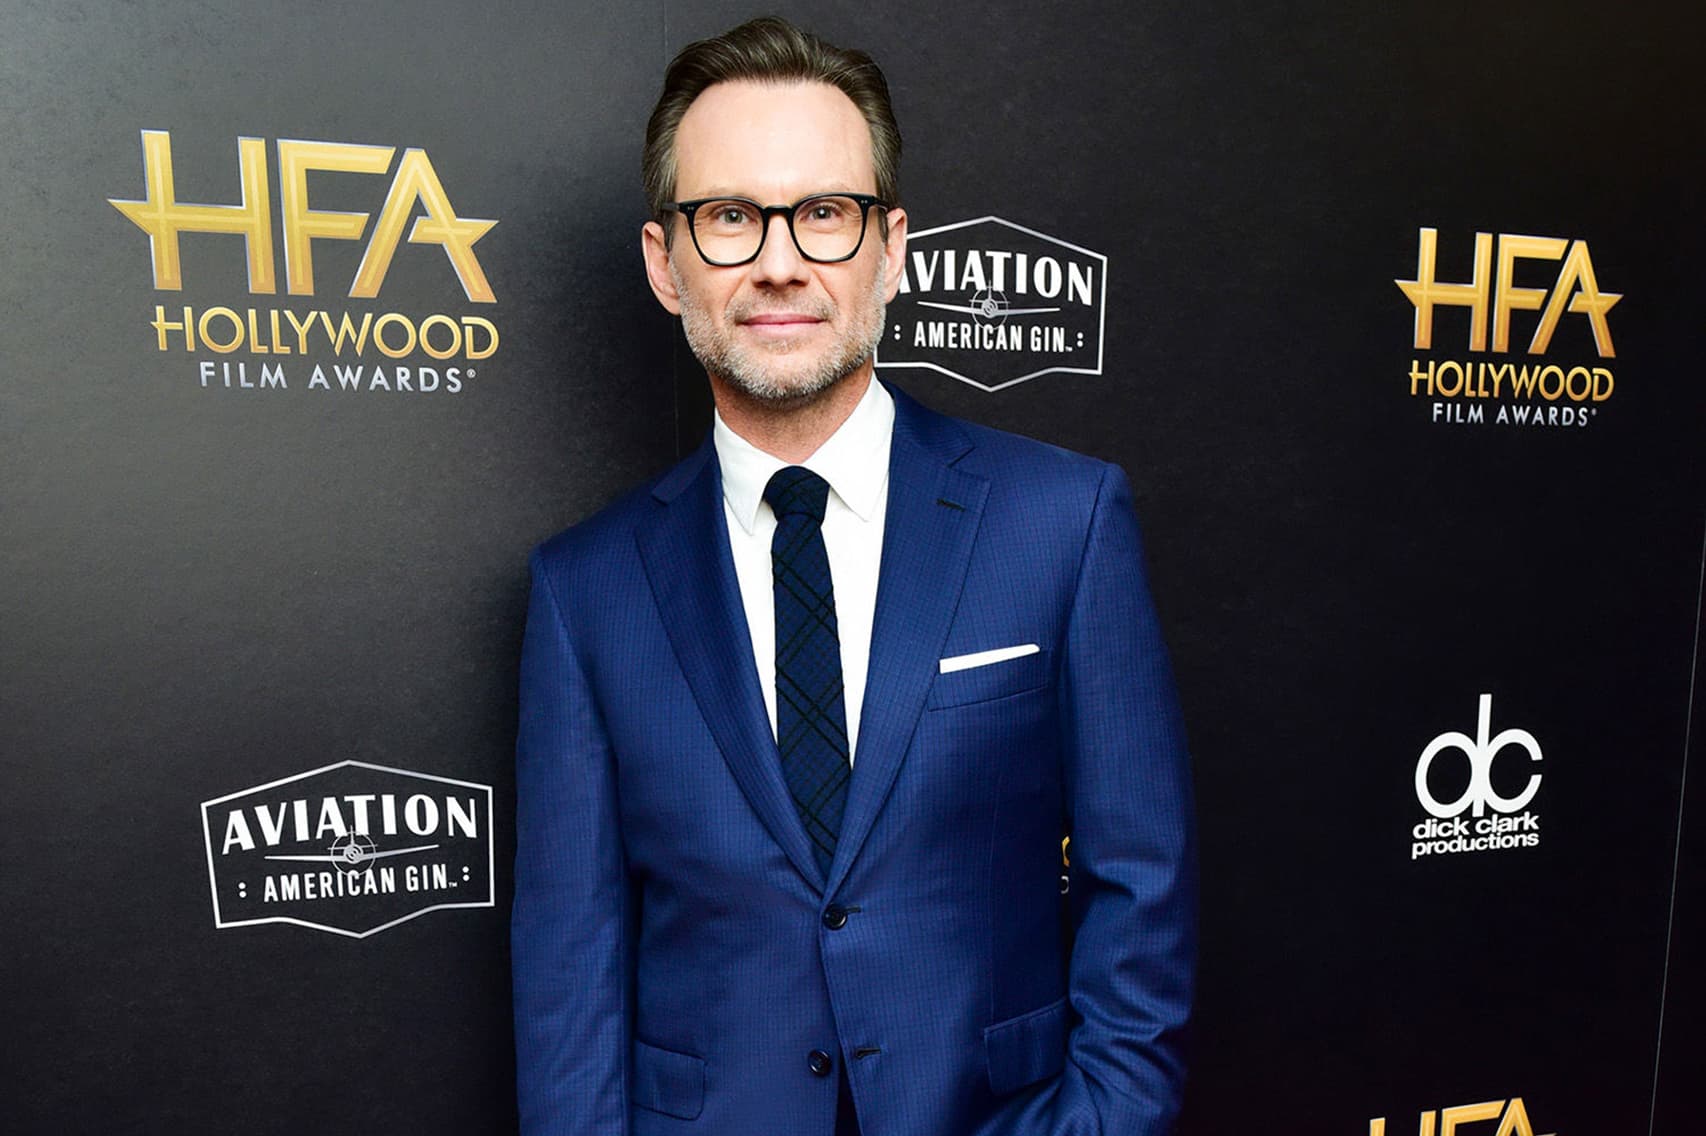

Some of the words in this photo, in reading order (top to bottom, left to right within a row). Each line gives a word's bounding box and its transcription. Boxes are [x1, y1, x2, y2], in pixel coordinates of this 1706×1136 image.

[107, 129, 499, 303] HFA
[1394, 227, 1624, 358] HFA
[150, 306, 500, 360] HOLLYWOOD
[914, 321, 1022, 351] AMERICAN
[200, 361, 288, 389] FILM
[1408, 360, 1614, 401] HOLLYWOOD
[1432, 402, 1484, 423] FILM
[222, 794, 477, 855] AVIATION
[1412, 816, 1470, 839] dick
[1475, 811, 1539, 834] clark
[1412, 832, 1539, 860] productions
[264, 867, 395, 902] AMERICAN
